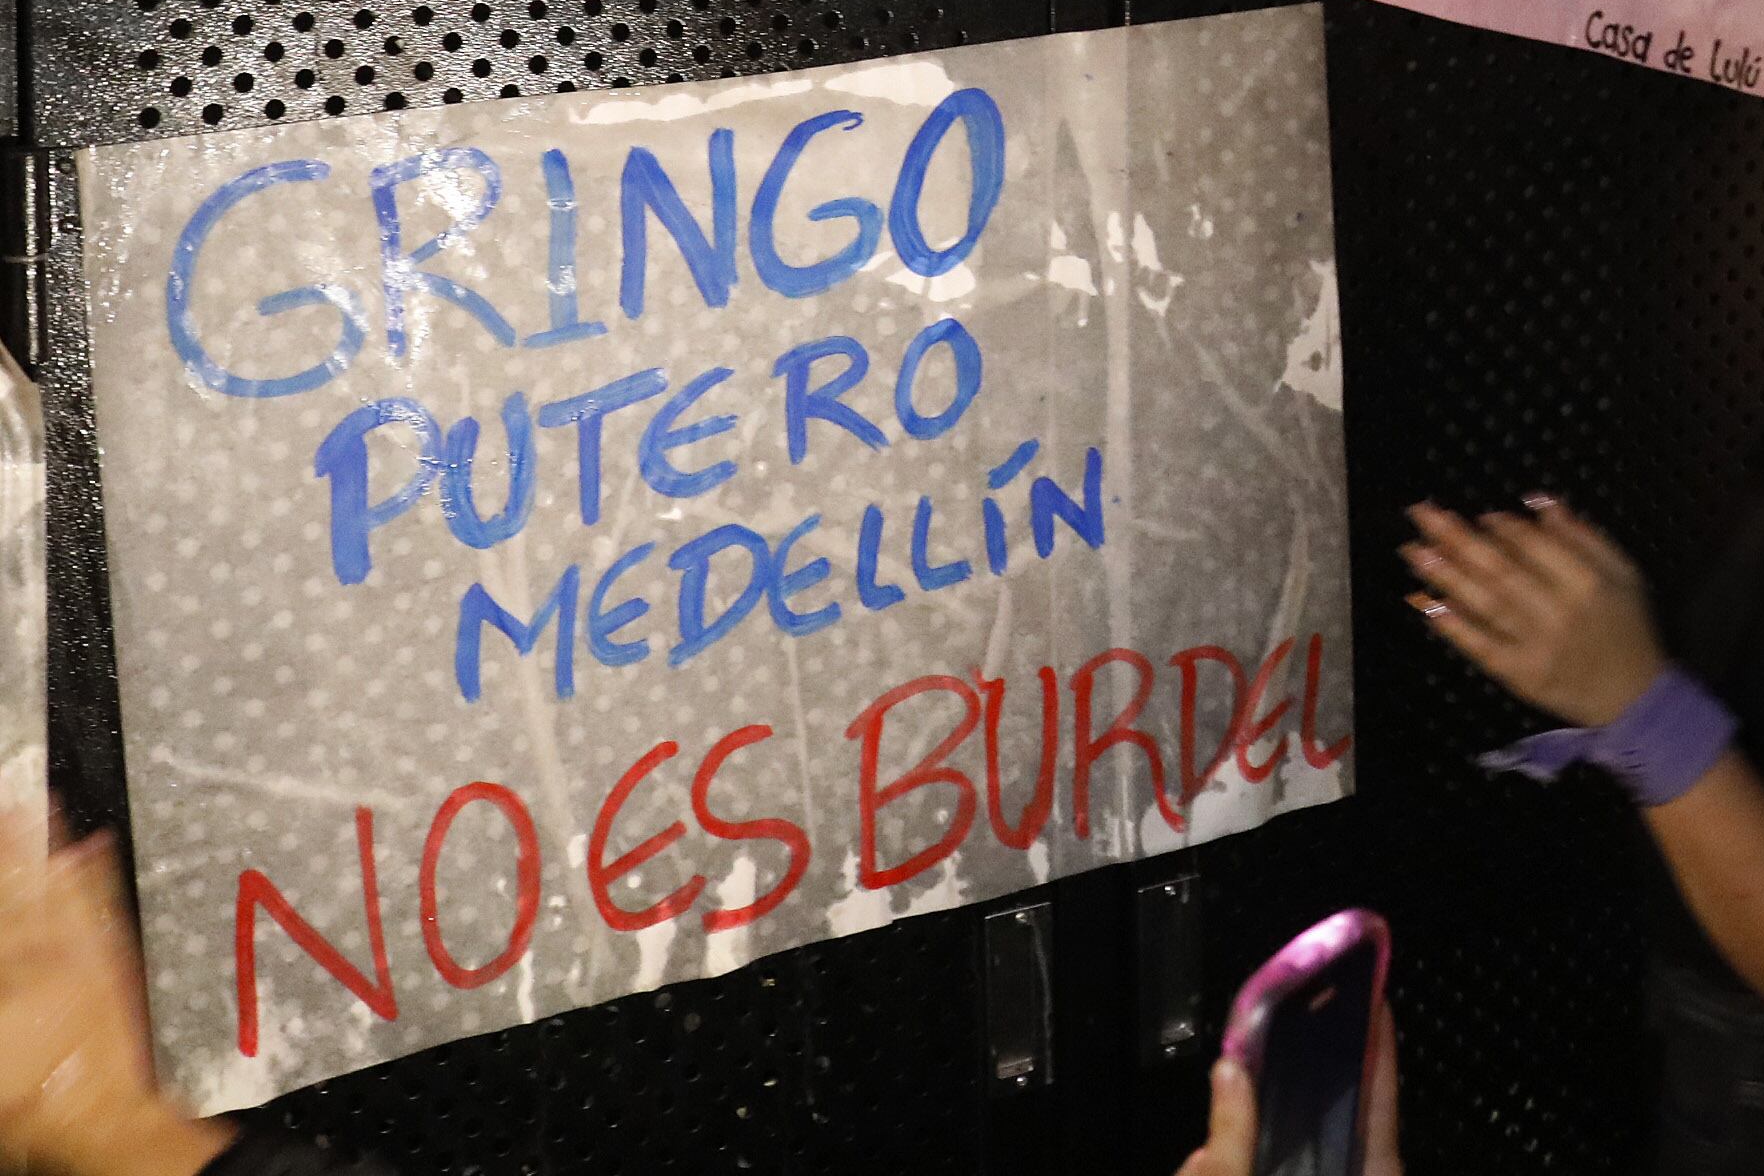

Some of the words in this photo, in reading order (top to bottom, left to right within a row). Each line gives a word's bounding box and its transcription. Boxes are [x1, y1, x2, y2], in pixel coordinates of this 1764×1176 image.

[1585, 10, 1653, 63] Casa
[1663, 30, 1695, 74] de
[165, 86, 1006, 400] GRINGO
[313, 317, 983, 586] PUTERO
[454, 437, 1106, 702] MEDELLÍN
[233, 781, 543, 1059] NO
[586, 724, 812, 934] ES
[844, 631, 1354, 891] BURDEL
